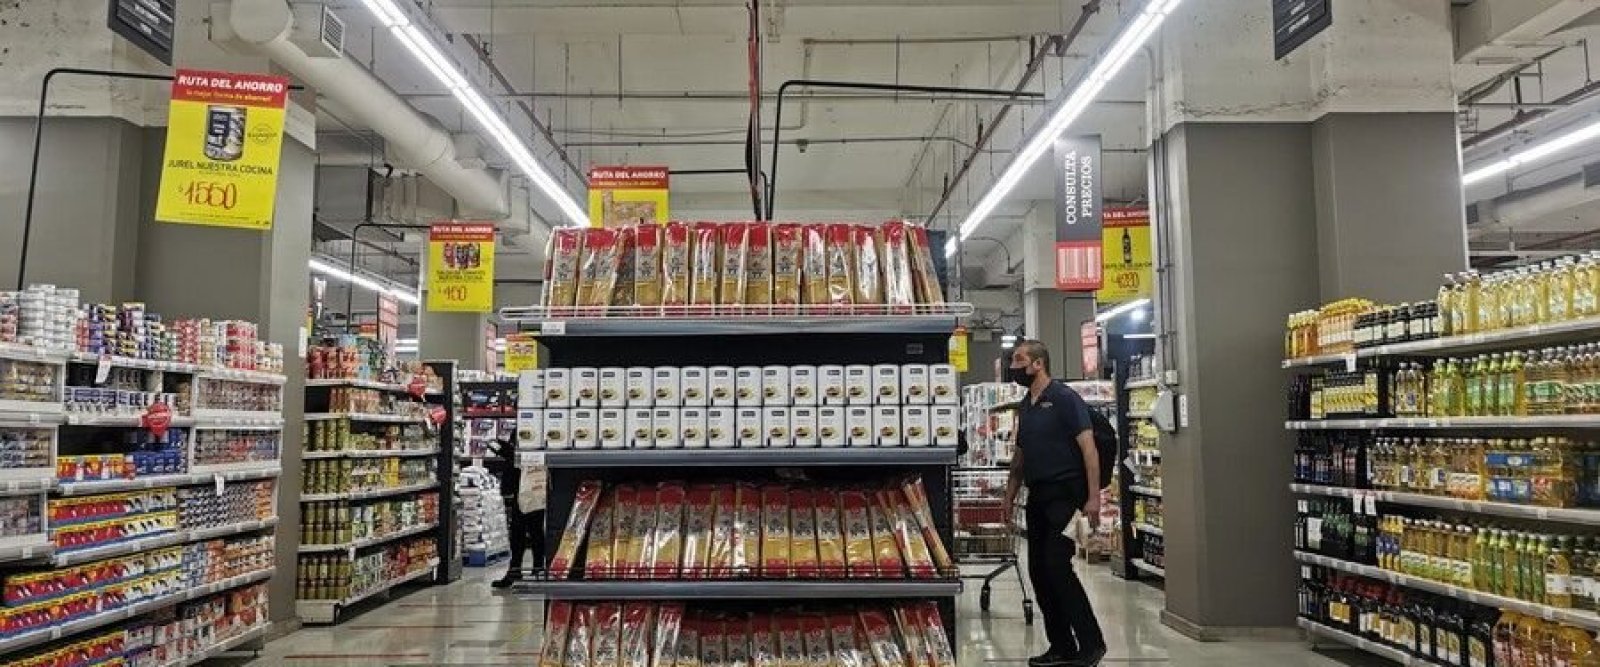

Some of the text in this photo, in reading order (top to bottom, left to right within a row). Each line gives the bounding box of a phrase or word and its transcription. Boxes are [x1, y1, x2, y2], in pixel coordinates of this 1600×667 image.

[178, 75, 283, 93] RUTA DEL AHORRO
[168, 159, 195, 169] JUREL
[196, 161, 238, 172] NUESTRA
[239, 164, 273, 175] COCINA
[591, 170, 666, 179] RUTA DEL AHORRO
[1065, 150, 1077, 225] CONSULTA
[1081, 155, 1093, 218] PRECIOS
